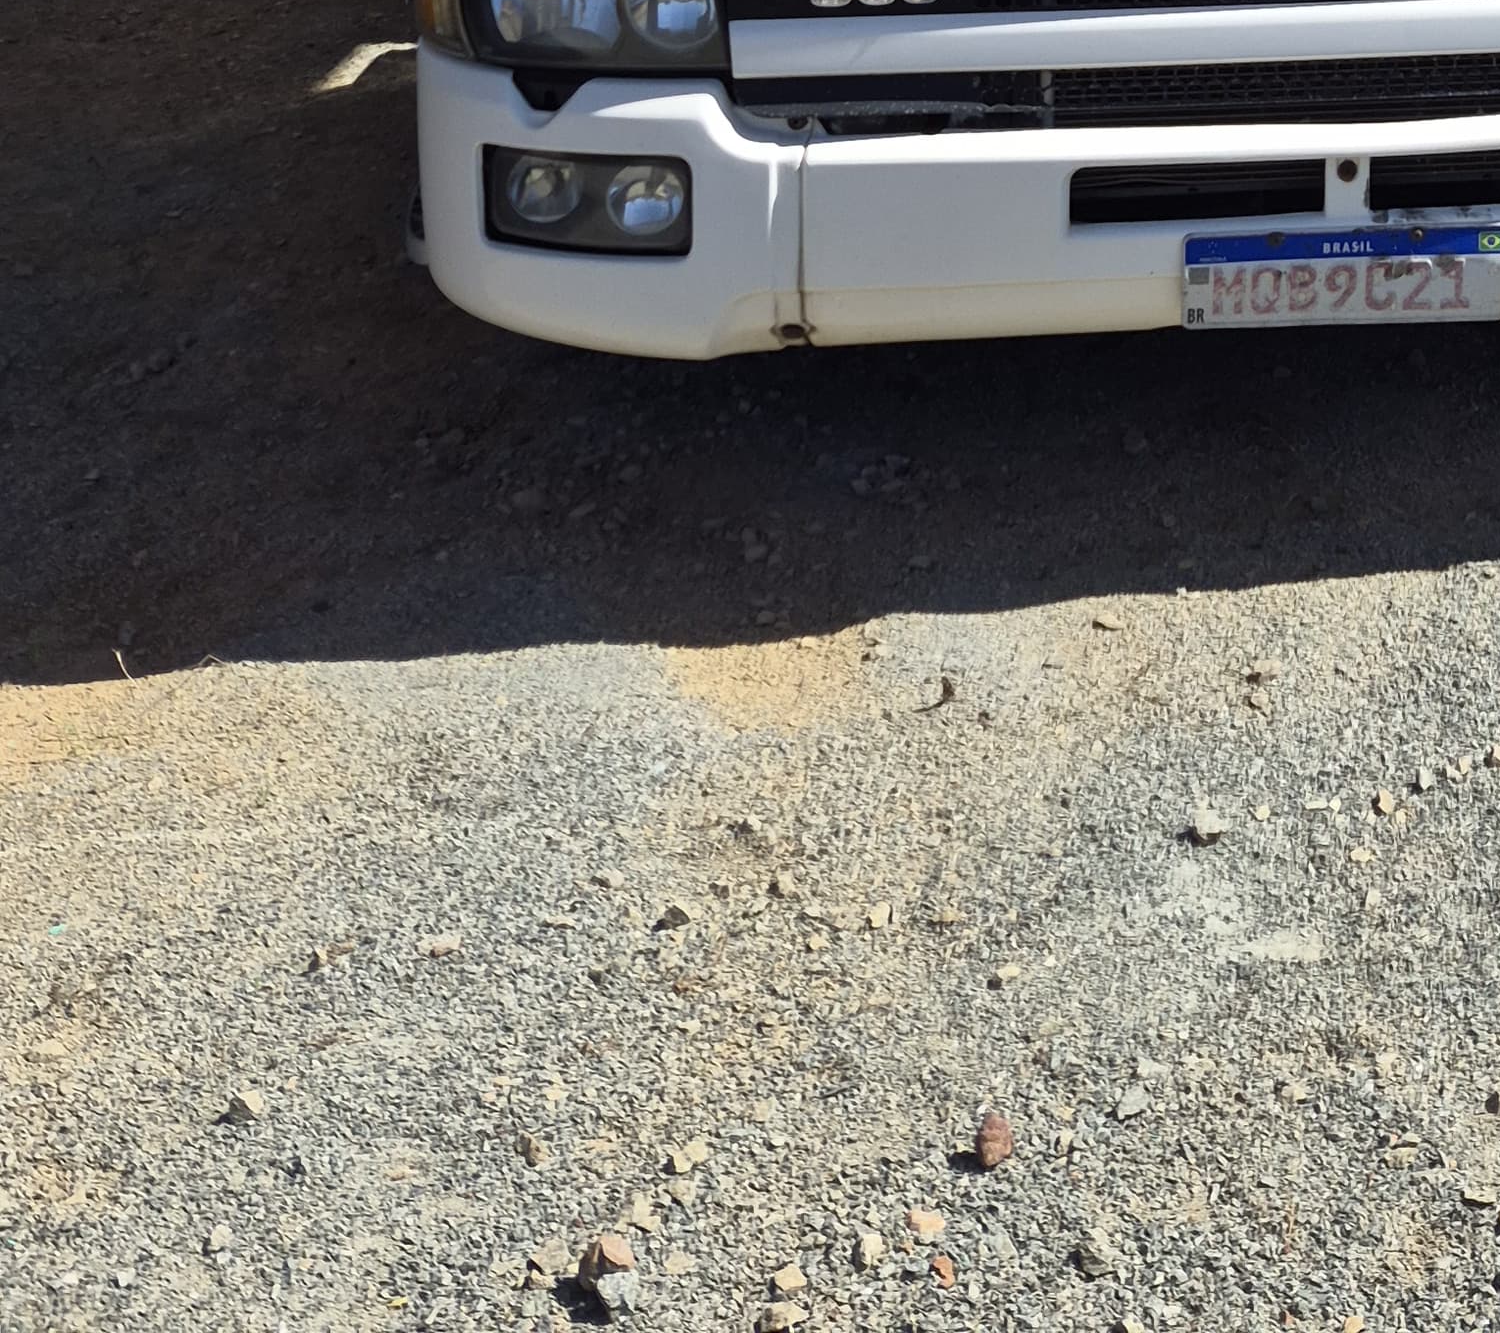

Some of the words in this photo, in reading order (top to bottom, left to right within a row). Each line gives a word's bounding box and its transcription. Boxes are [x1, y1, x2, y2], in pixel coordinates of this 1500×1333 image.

[1322, 241, 1374, 254] BRASIL
[1211, 256, 1470, 316] MQB9C21
[1186, 307, 1205, 324] BR
